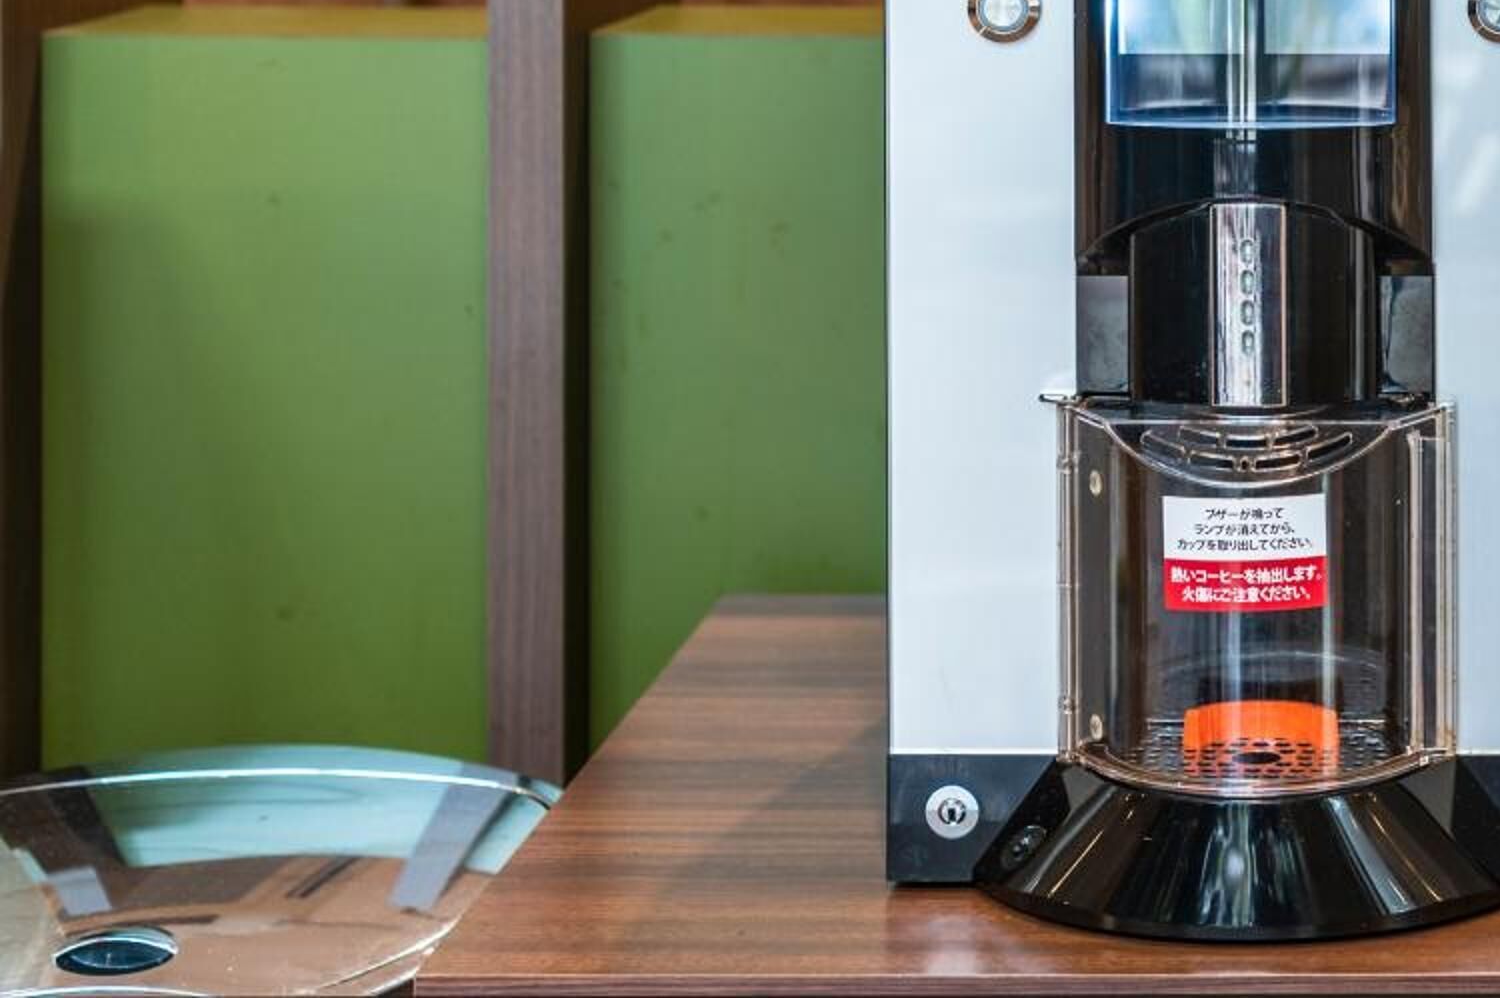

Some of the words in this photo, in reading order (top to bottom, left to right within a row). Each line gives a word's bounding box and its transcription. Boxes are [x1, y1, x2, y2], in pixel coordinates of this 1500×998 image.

[1204, 507, 1285, 520] ブザーが鳴って
